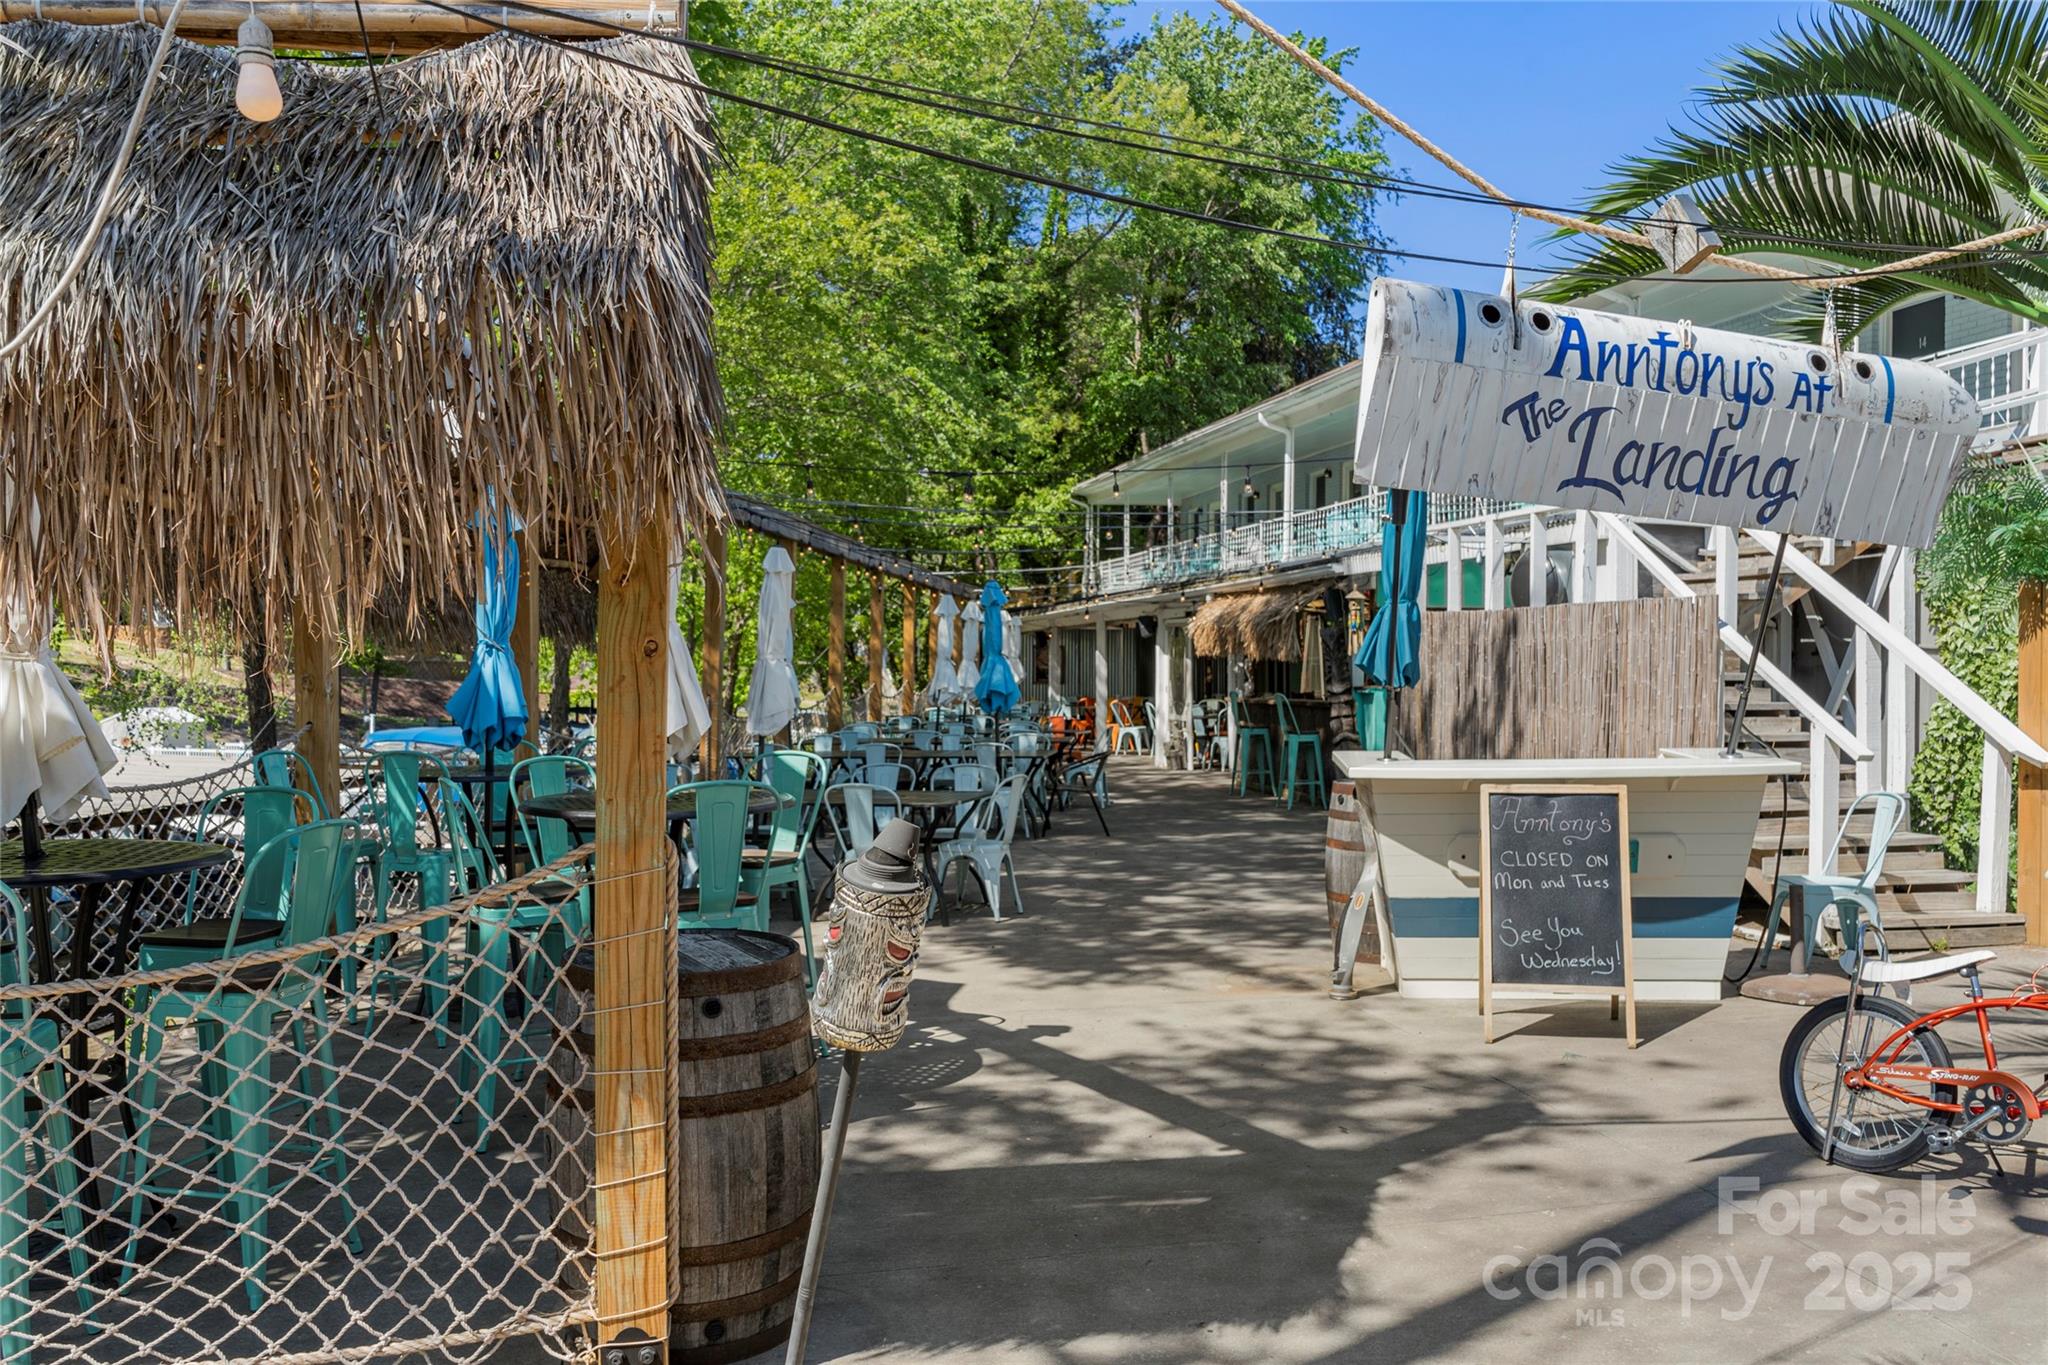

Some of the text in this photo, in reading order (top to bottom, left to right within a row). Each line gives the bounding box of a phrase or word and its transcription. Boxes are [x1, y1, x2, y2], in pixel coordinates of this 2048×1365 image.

[1919, 336, 1927, 349] 14
[1544, 316, 1775, 431] Anntony's
[1502, 391, 1800, 525] The Landing
[1493, 797, 1612, 845] Anntony's
[1501, 850, 1609, 867] CLOSED ON
[1495, 872, 1610, 890] Mon and Tues
[1499, 917, 1584, 950] See You
[1520, 940, 1622, 975] Wednesday!
